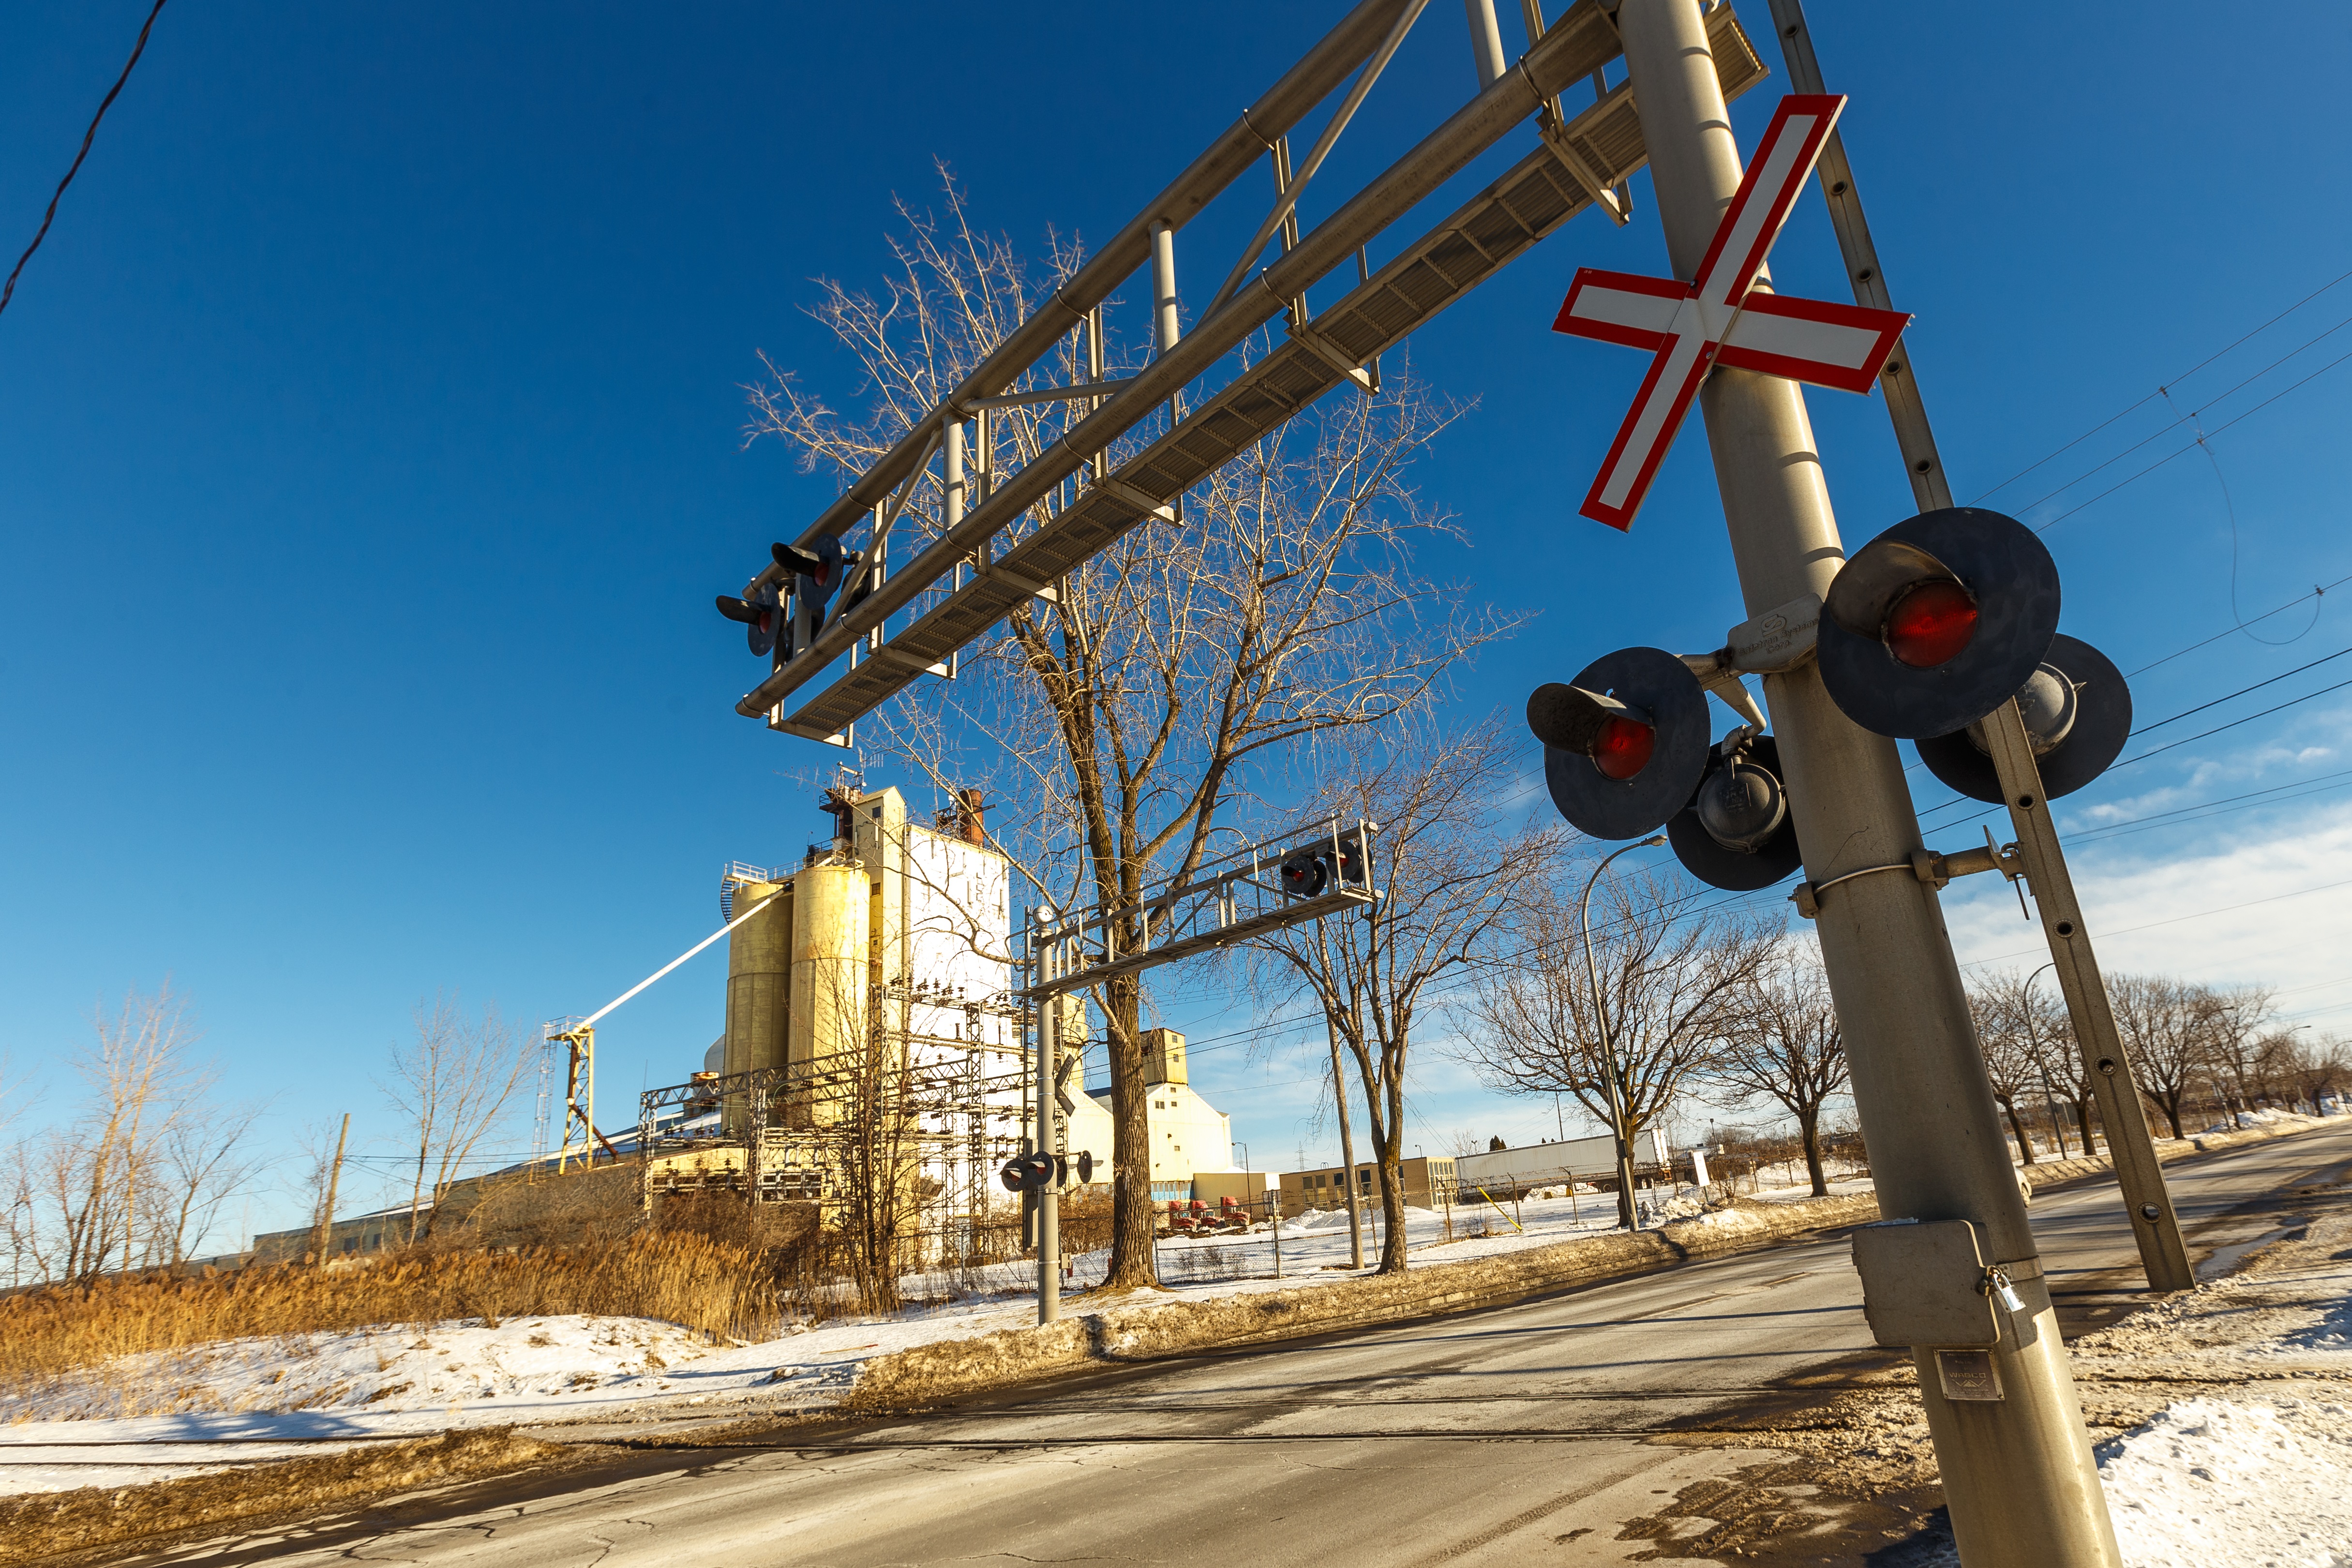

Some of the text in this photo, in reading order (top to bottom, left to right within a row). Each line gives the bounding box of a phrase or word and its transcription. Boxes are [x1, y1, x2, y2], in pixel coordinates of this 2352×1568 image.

[1738, 618, 1819, 656] Safetran Systems
[1767, 640, 1792, 654] Corp.
